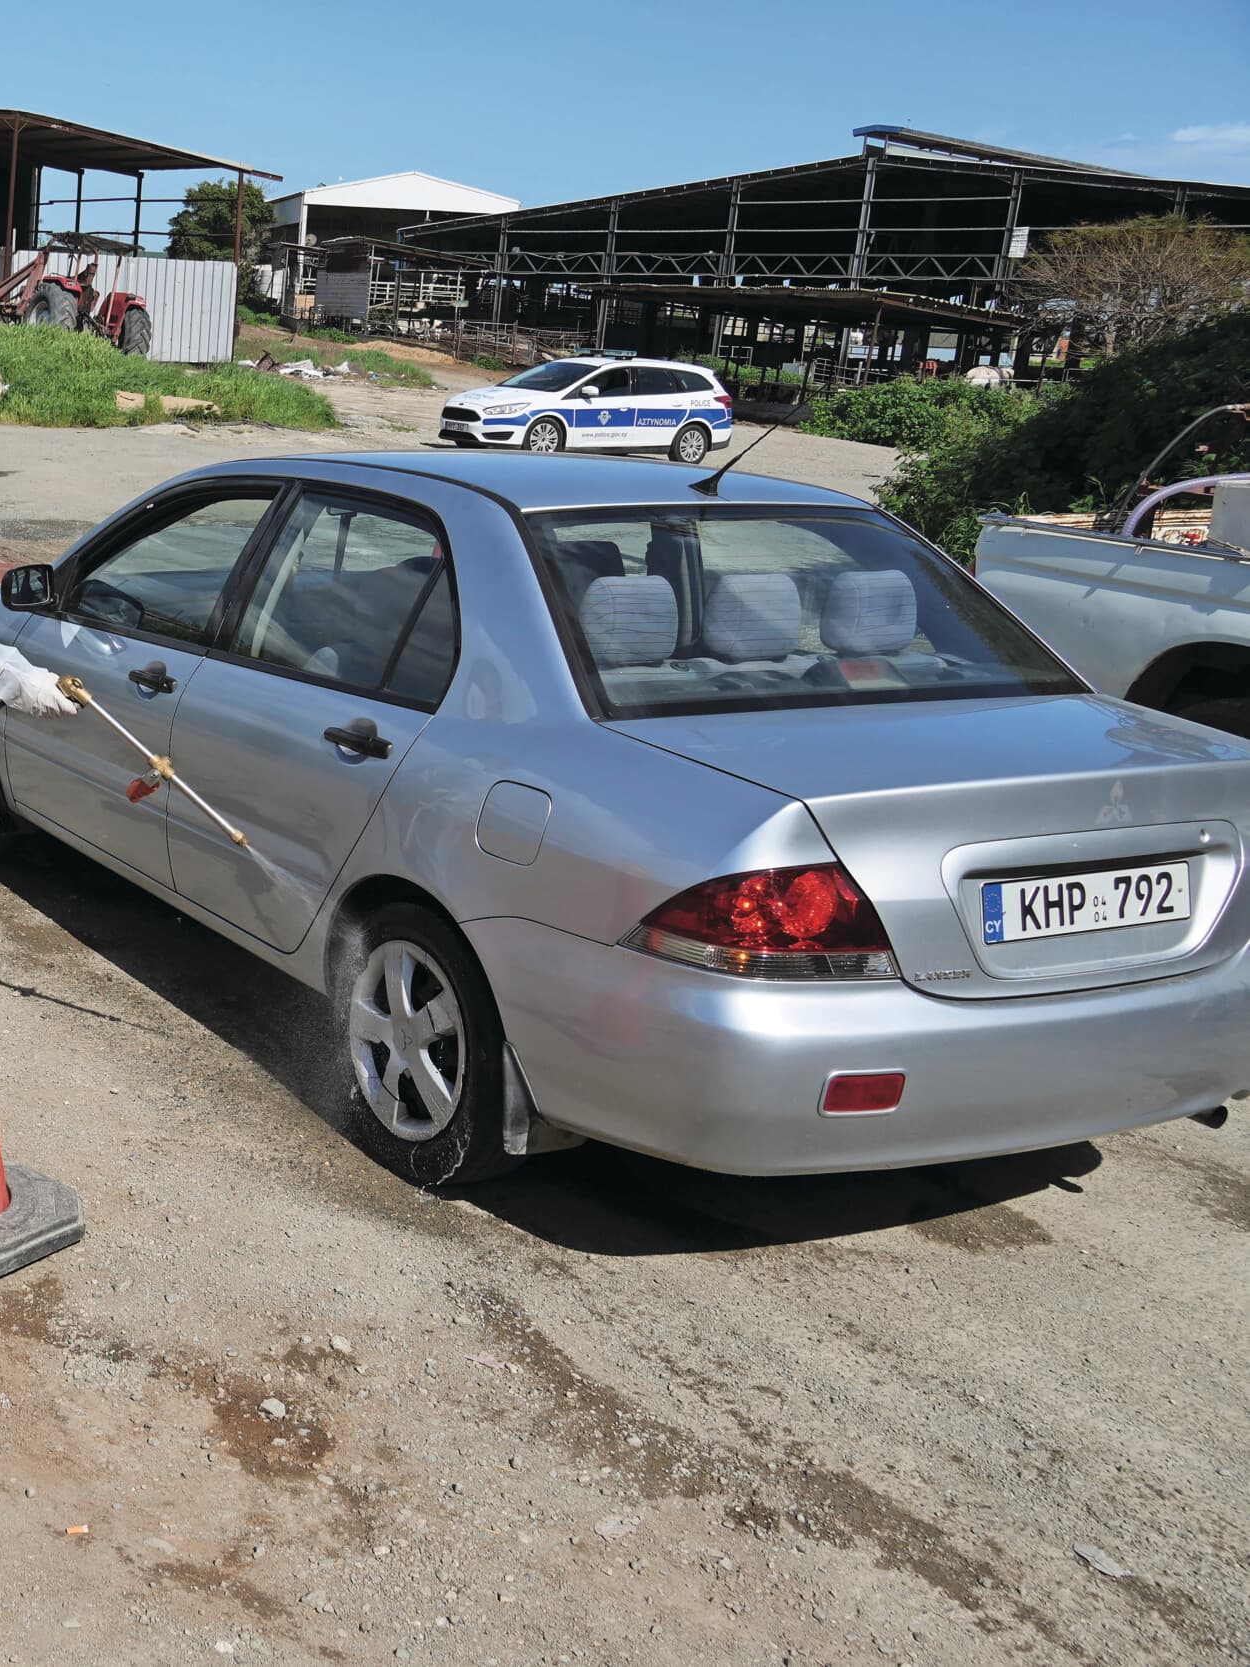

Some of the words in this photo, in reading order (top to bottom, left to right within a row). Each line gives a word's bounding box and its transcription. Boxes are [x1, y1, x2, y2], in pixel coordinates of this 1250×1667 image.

[690, 399, 711, 407] POLICE
[637, 417, 677, 426] ΑΣΤΥΝΟΜΙΑ
[1019, 881, 1086, 932] KHP
[1113, 871, 1175, 919] 792
[1093, 895, 1107, 908] 04
[1093, 911, 1108, 923] 04
[985, 920, 1002, 934] CY
